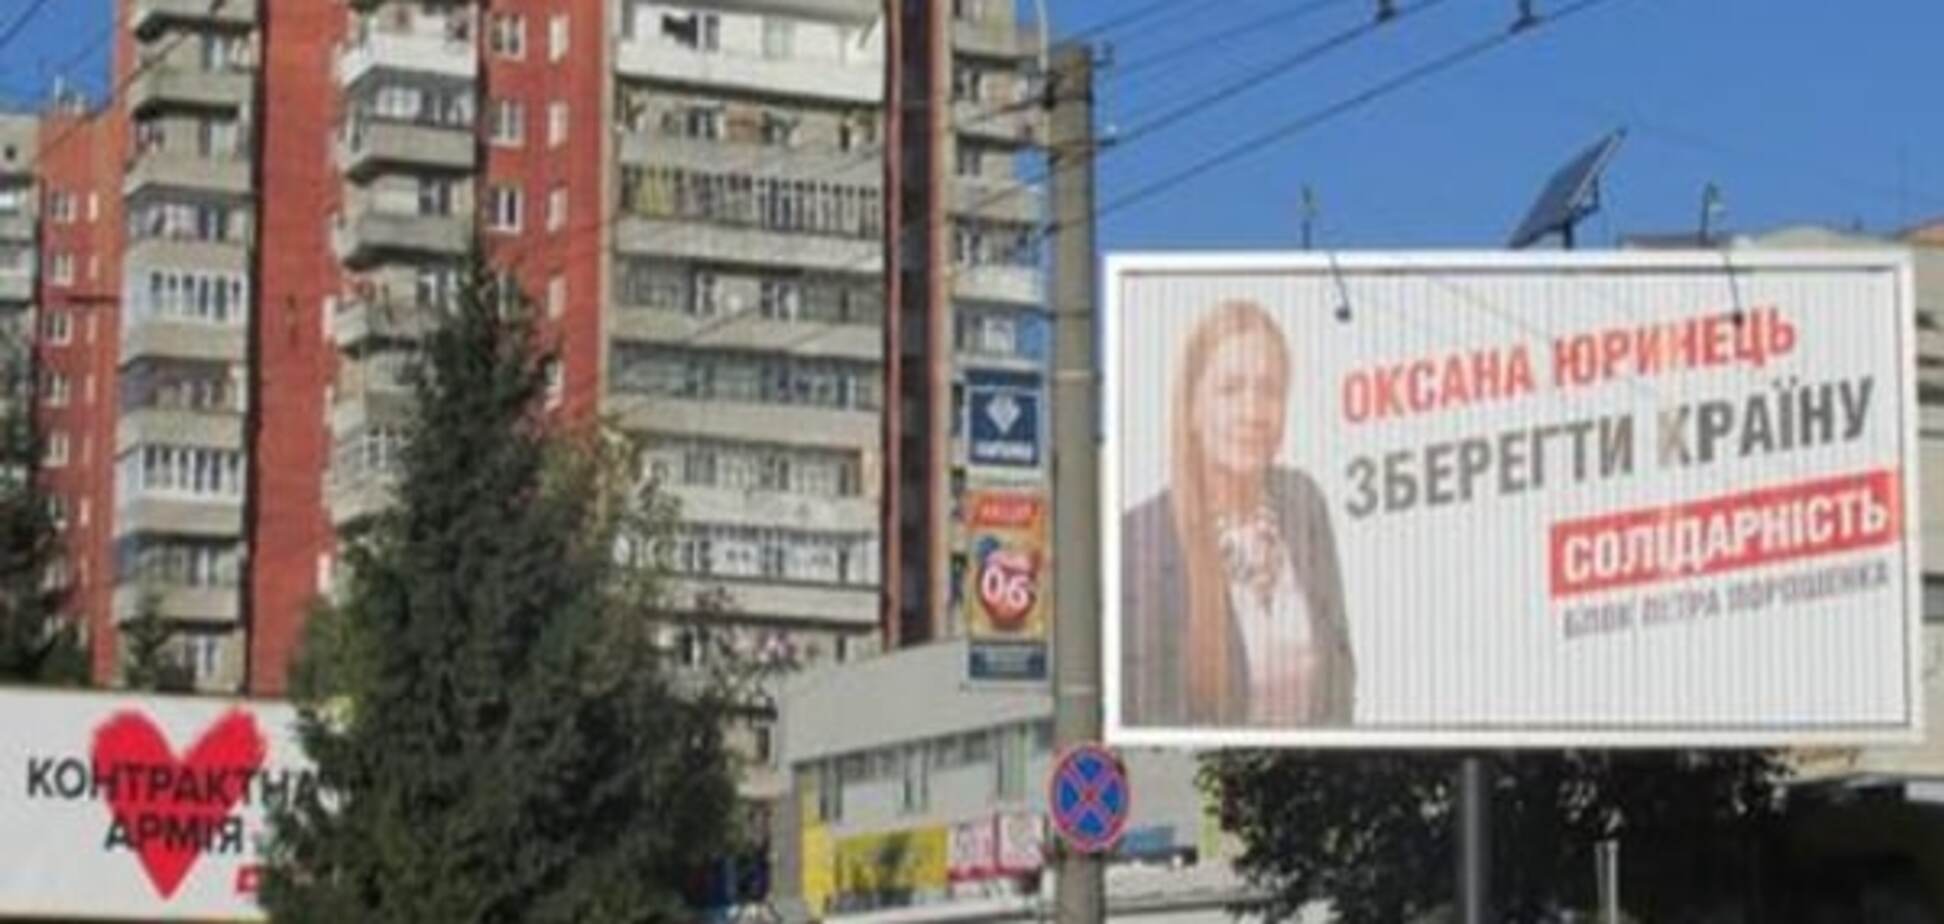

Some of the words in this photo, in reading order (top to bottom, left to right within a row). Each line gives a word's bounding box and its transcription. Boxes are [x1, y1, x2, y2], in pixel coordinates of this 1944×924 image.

[1343, 345, 1534, 424] ОКСАНА
[1553, 307, 1796, 388] ЮРИНЕЦЬ
[1346, 414, 1635, 519] ЗБЕРЕГТИ
[1658, 377, 1874, 468] КРАЇНУ
[1563, 490, 1888, 582] СОЛІДАРНІСТЬ
[104, 814, 243, 853] АРМІЯ
